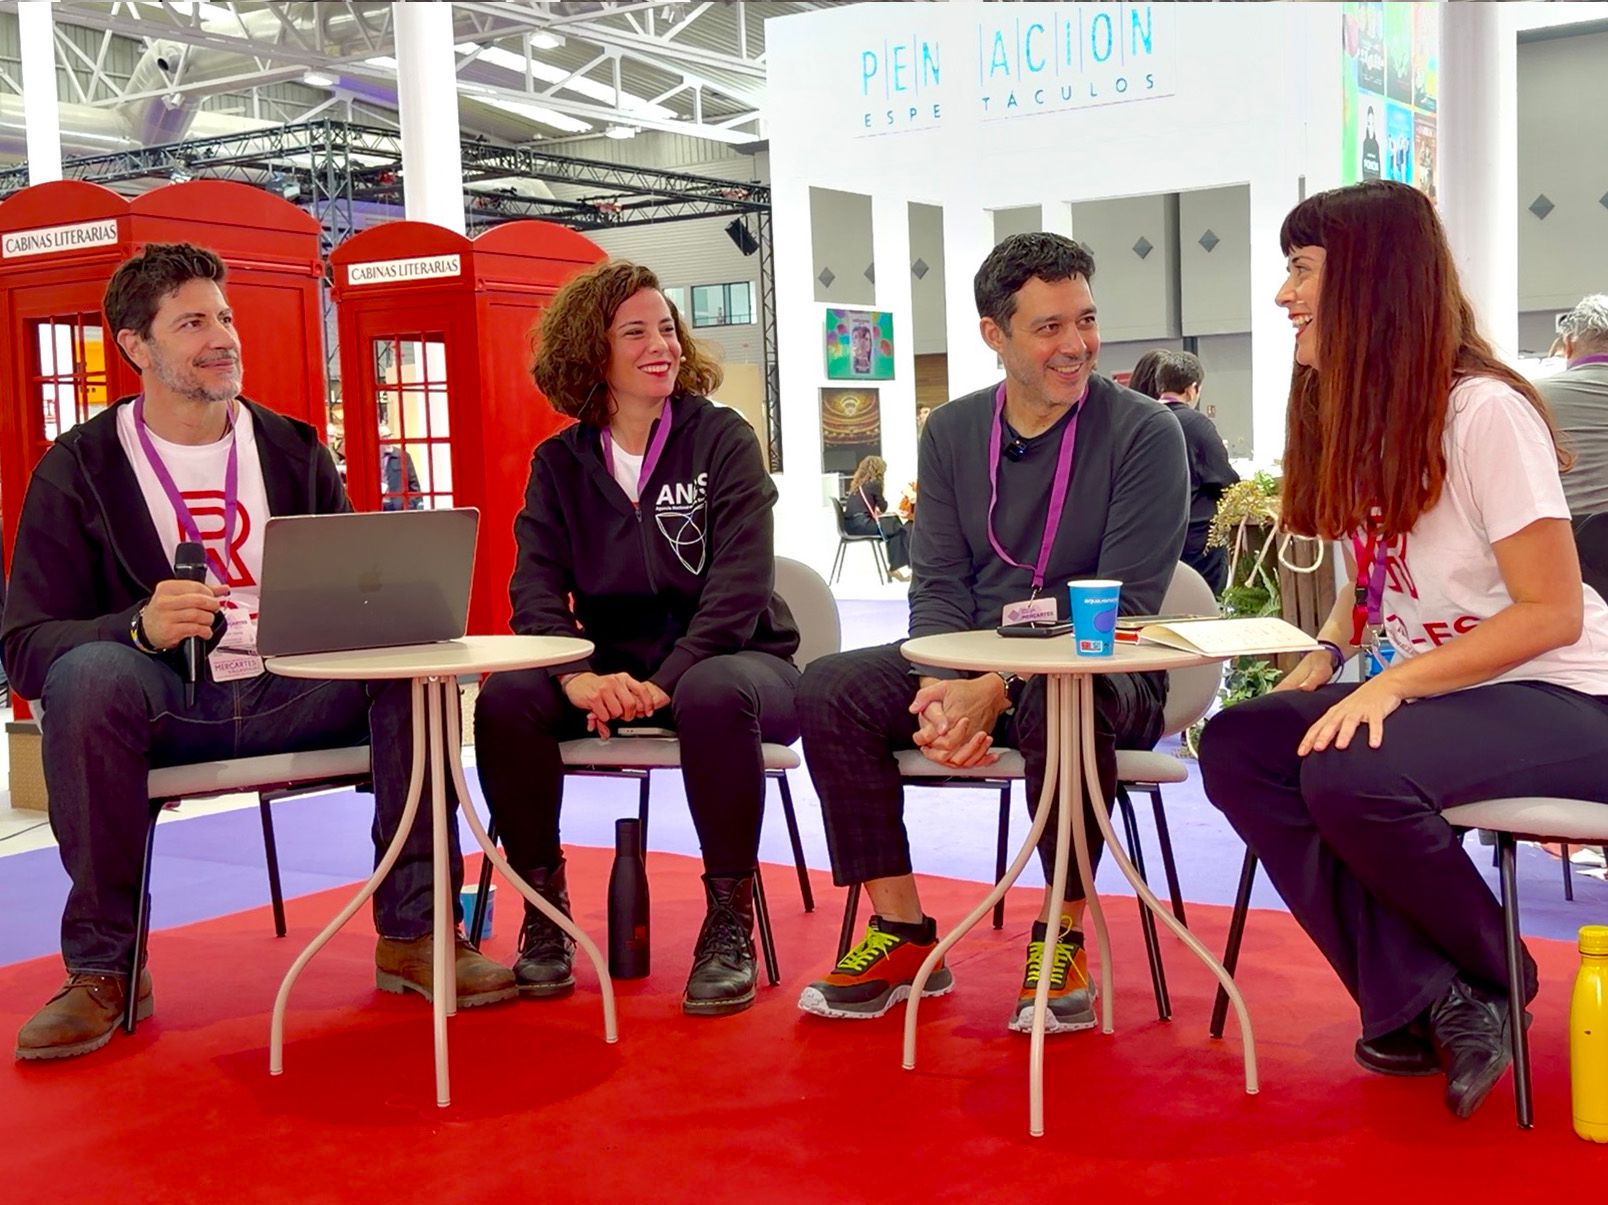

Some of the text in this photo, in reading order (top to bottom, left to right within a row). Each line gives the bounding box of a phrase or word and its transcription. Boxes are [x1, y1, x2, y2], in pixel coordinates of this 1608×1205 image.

[5, 224, 117, 254] CABINAS LITERARIAS
[351, 258, 459, 281] CABINAS LITERARIAS
